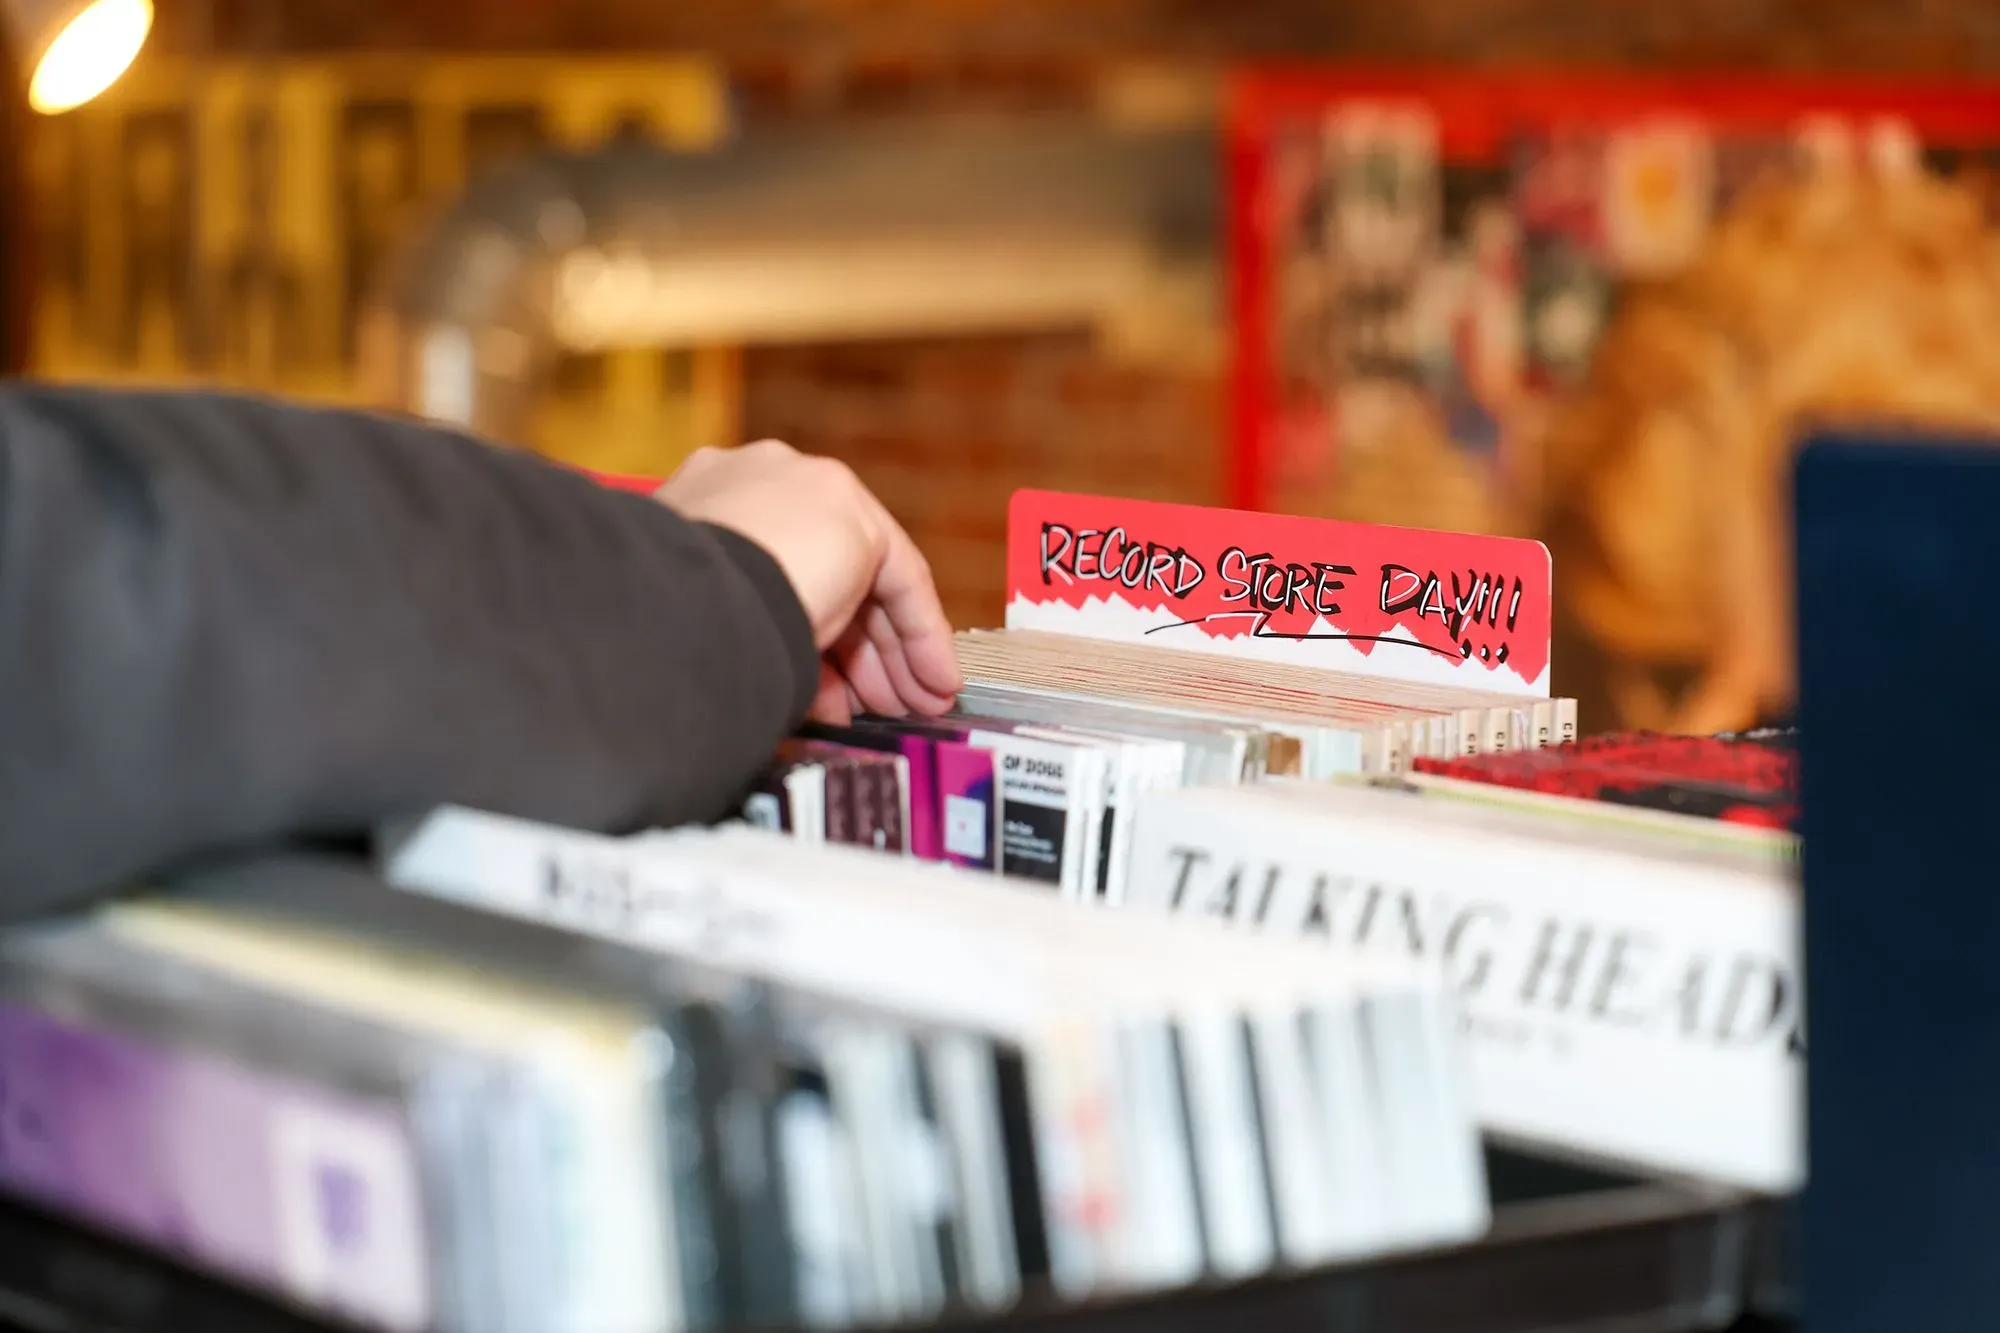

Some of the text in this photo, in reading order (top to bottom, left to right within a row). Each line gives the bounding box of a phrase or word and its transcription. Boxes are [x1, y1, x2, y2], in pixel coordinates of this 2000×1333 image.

[1041, 521, 1523, 663] RECORD STORE DAY!!!
[1169, 845, 1508, 997] TALKING
